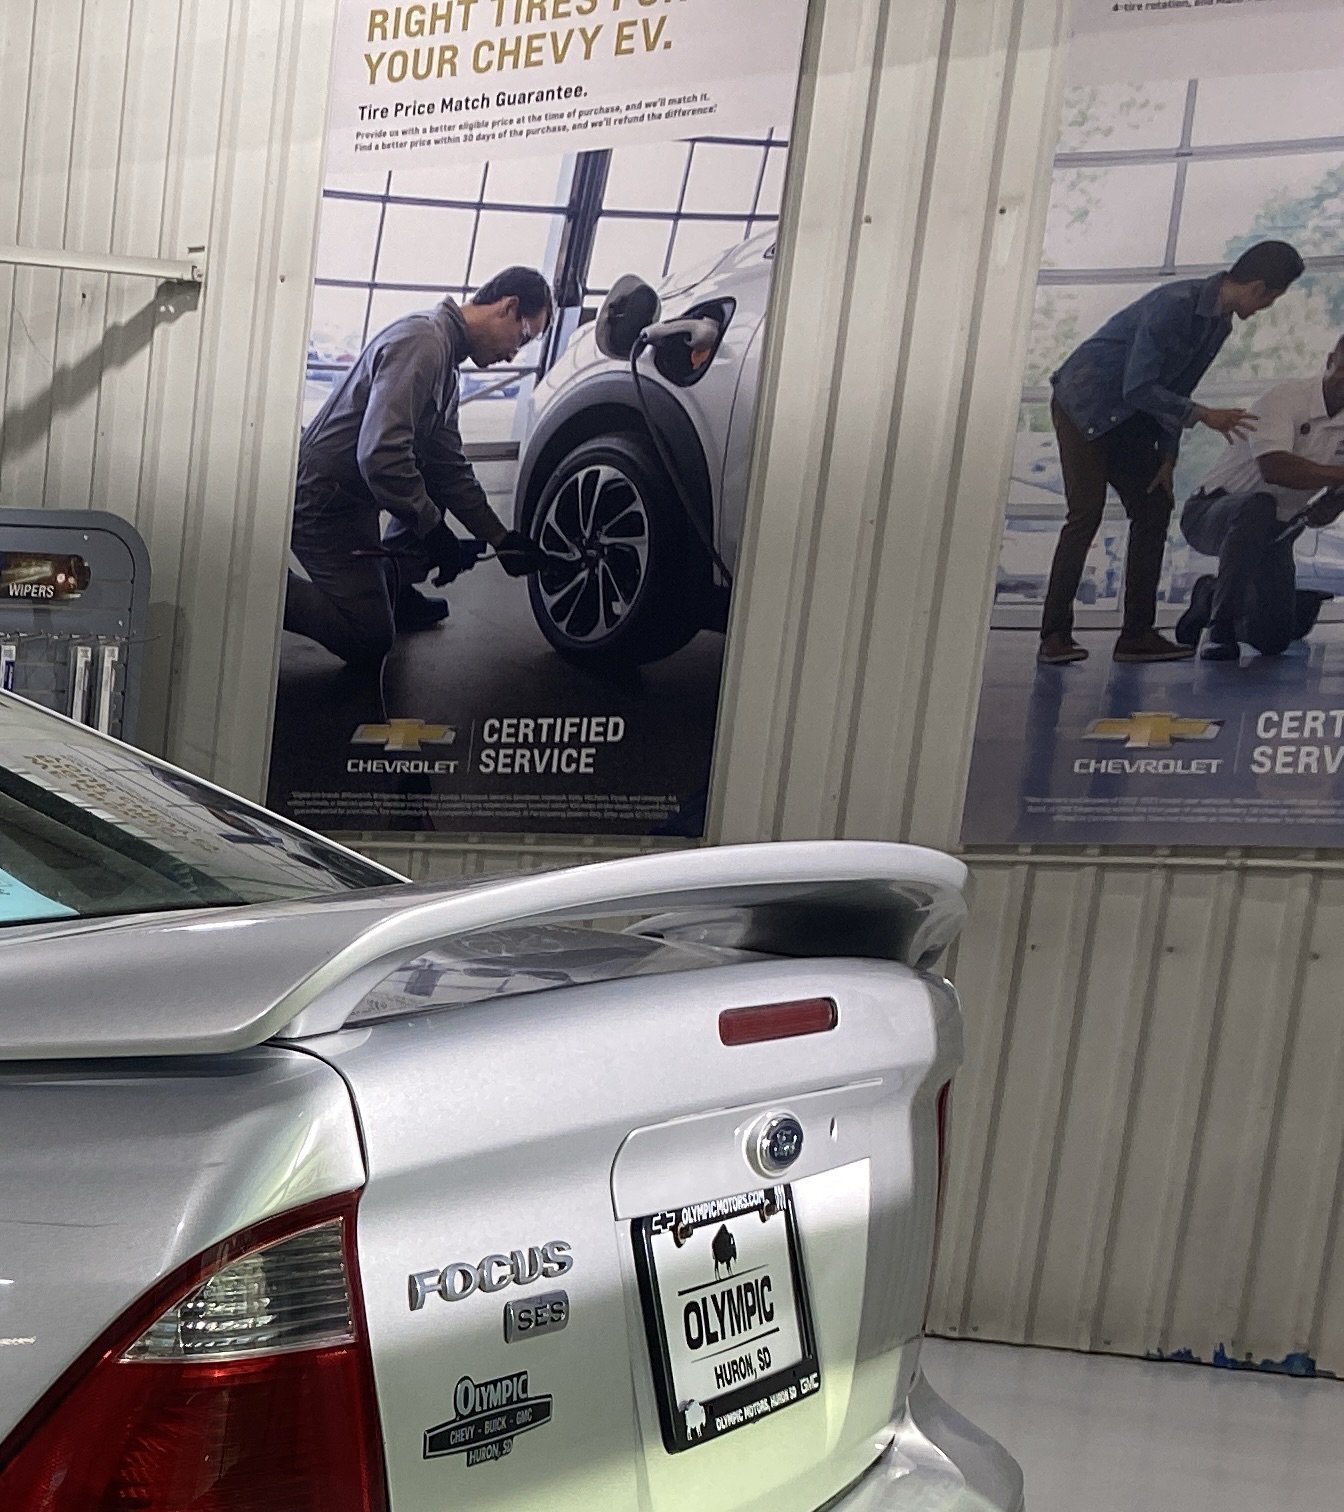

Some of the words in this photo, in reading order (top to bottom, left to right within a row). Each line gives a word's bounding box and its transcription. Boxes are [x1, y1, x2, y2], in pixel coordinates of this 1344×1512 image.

[367, 1, 470, 42] RIGHT
[364, 44, 459, 85] YOUR
[473, 24, 604, 73] CHEVY
[615, 15, 672, 56] EV.
[356, 129, 387, 140] Provide
[402, 127, 420, 136] with
[429, 124, 456, 133] better
[459, 121, 489, 131] eligible
[492, 118, 514, 129] price
[545, 111, 565, 122] time
[578, 104, 623, 119] purchase,
[625, 100, 642, 111] and
[668, 94, 698, 106] match
[358, 104, 389, 120] Tire
[394, 100, 436, 118] Price
[440, 93, 490, 114] Match
[495, 85, 588, 107] Guarantee.
[355, 143, 372, 152] Find
[382, 140, 407, 150] better
[410, 139, 432, 150] price
[434, 136, 461, 146] within
[476, 131, 496, 142] days
[526, 123, 570, 138] purchase,
[571, 120, 588, 131] and
[613, 113, 645, 126] refund
[647, 110, 663, 121] the
[9, 583, 55, 598] WIPERS
[482, 716, 626, 743] CERTIFIED
[1256, 710, 1344, 739] CERT
[346, 759, 459, 774] CHEVROLET
[479, 747, 597, 774] SERVICE
[1073, 758, 1223, 774] CHEVROLET
[1250, 745, 1344, 774] SERV
[681, 1189, 765, 1225] OLYMPICMOTORS.COM
[408, 1240, 574, 1311] FOCUS
[517, 1301, 566, 1331] SES
[684, 1275, 774, 1350] OLYMPIC
[714, 1353, 757, 1389] HURON,
[757, 1346, 772, 1371] SD
[715, 1410, 744, 1431] OLYMPIC
[788, 1385, 797, 1400] SD
[799, 1372, 820, 1395] GMC
[450, 1424, 475, 1445] CHEVY
[484, 1416, 507, 1434] BUICK
[516, 1407, 533, 1424] GMC
[502, 1438, 513, 1455] SD
